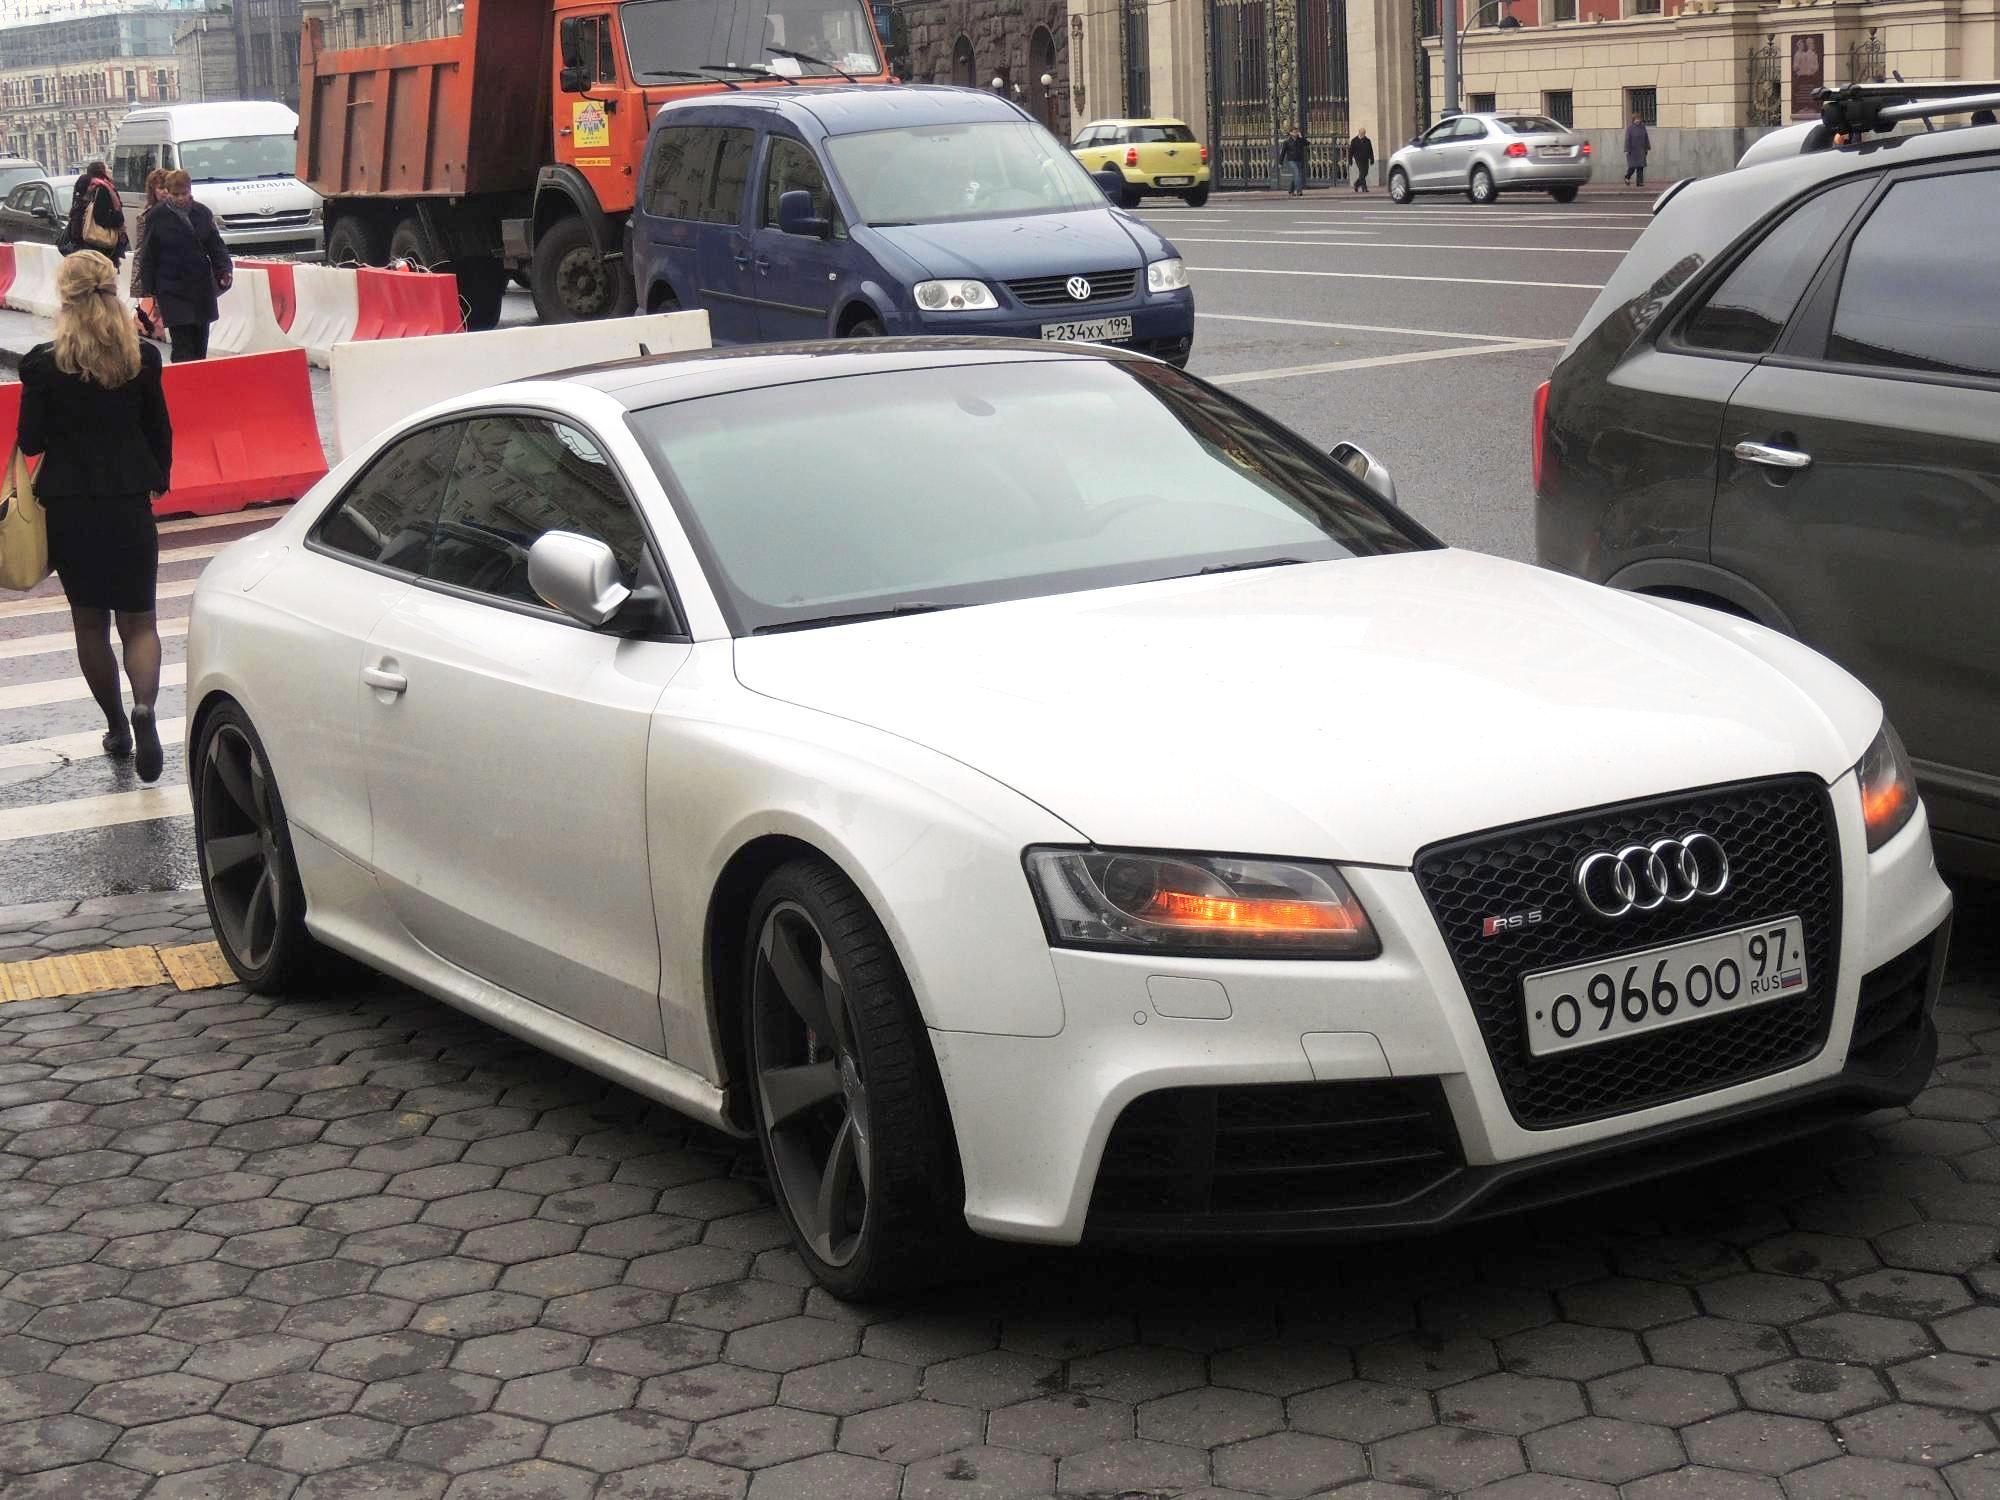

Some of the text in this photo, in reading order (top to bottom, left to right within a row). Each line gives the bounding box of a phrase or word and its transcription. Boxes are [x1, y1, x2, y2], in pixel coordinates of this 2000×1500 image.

[226, 181, 296, 192] NORDAVIA
[1108, 318, 1128, 332] 199
[1748, 927, 1787, 977] 97
[1750, 975, 1781, 995] RUS
